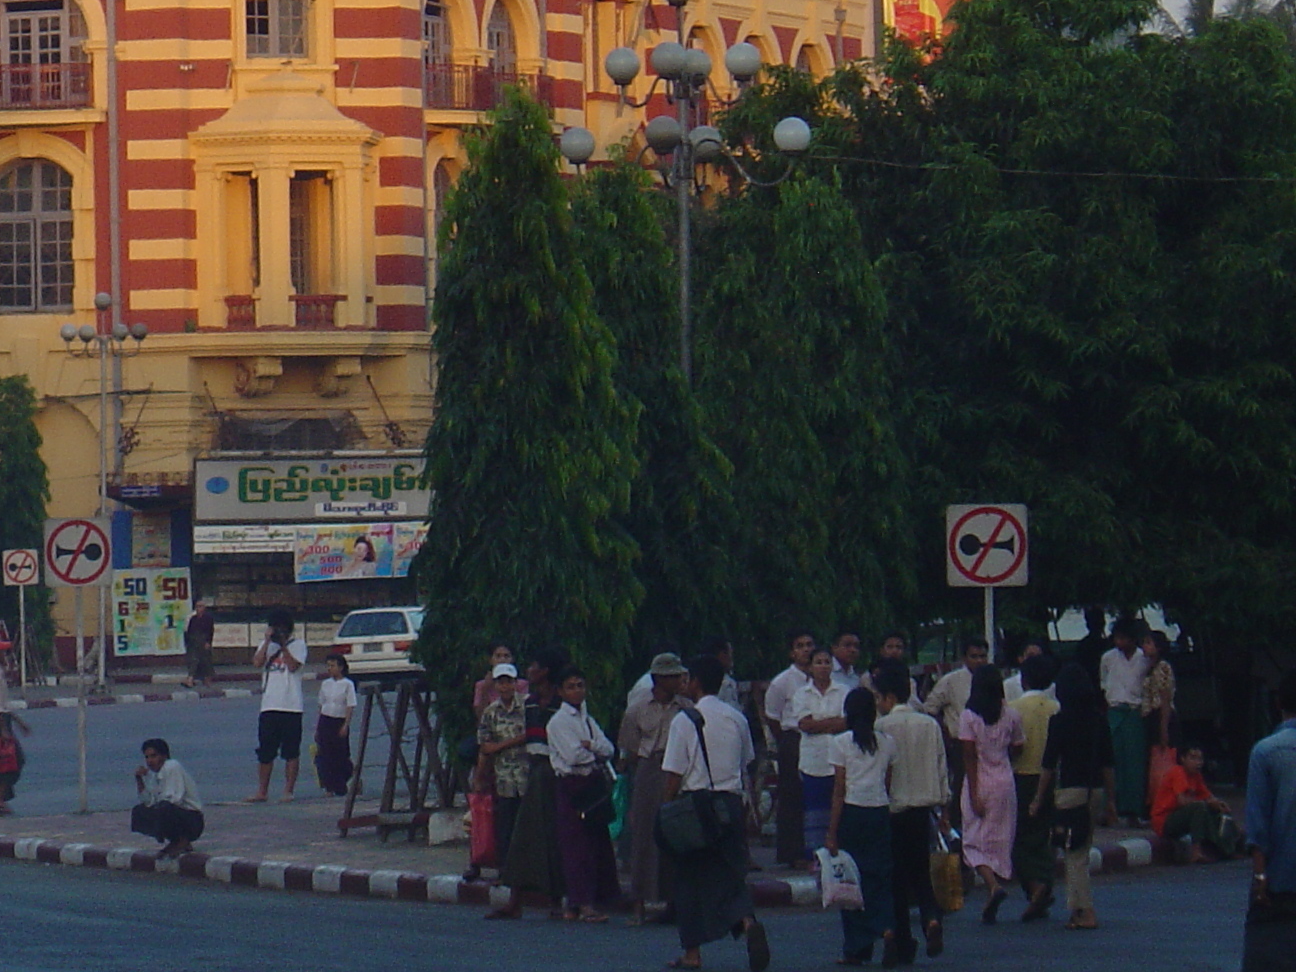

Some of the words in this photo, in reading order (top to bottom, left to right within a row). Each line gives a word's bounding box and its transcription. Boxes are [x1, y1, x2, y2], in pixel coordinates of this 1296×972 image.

[123, 577, 147, 596] 50
[162, 577, 189, 601] 50
[117, 601, 129, 616] 6
[117, 635, 128, 651] 5
